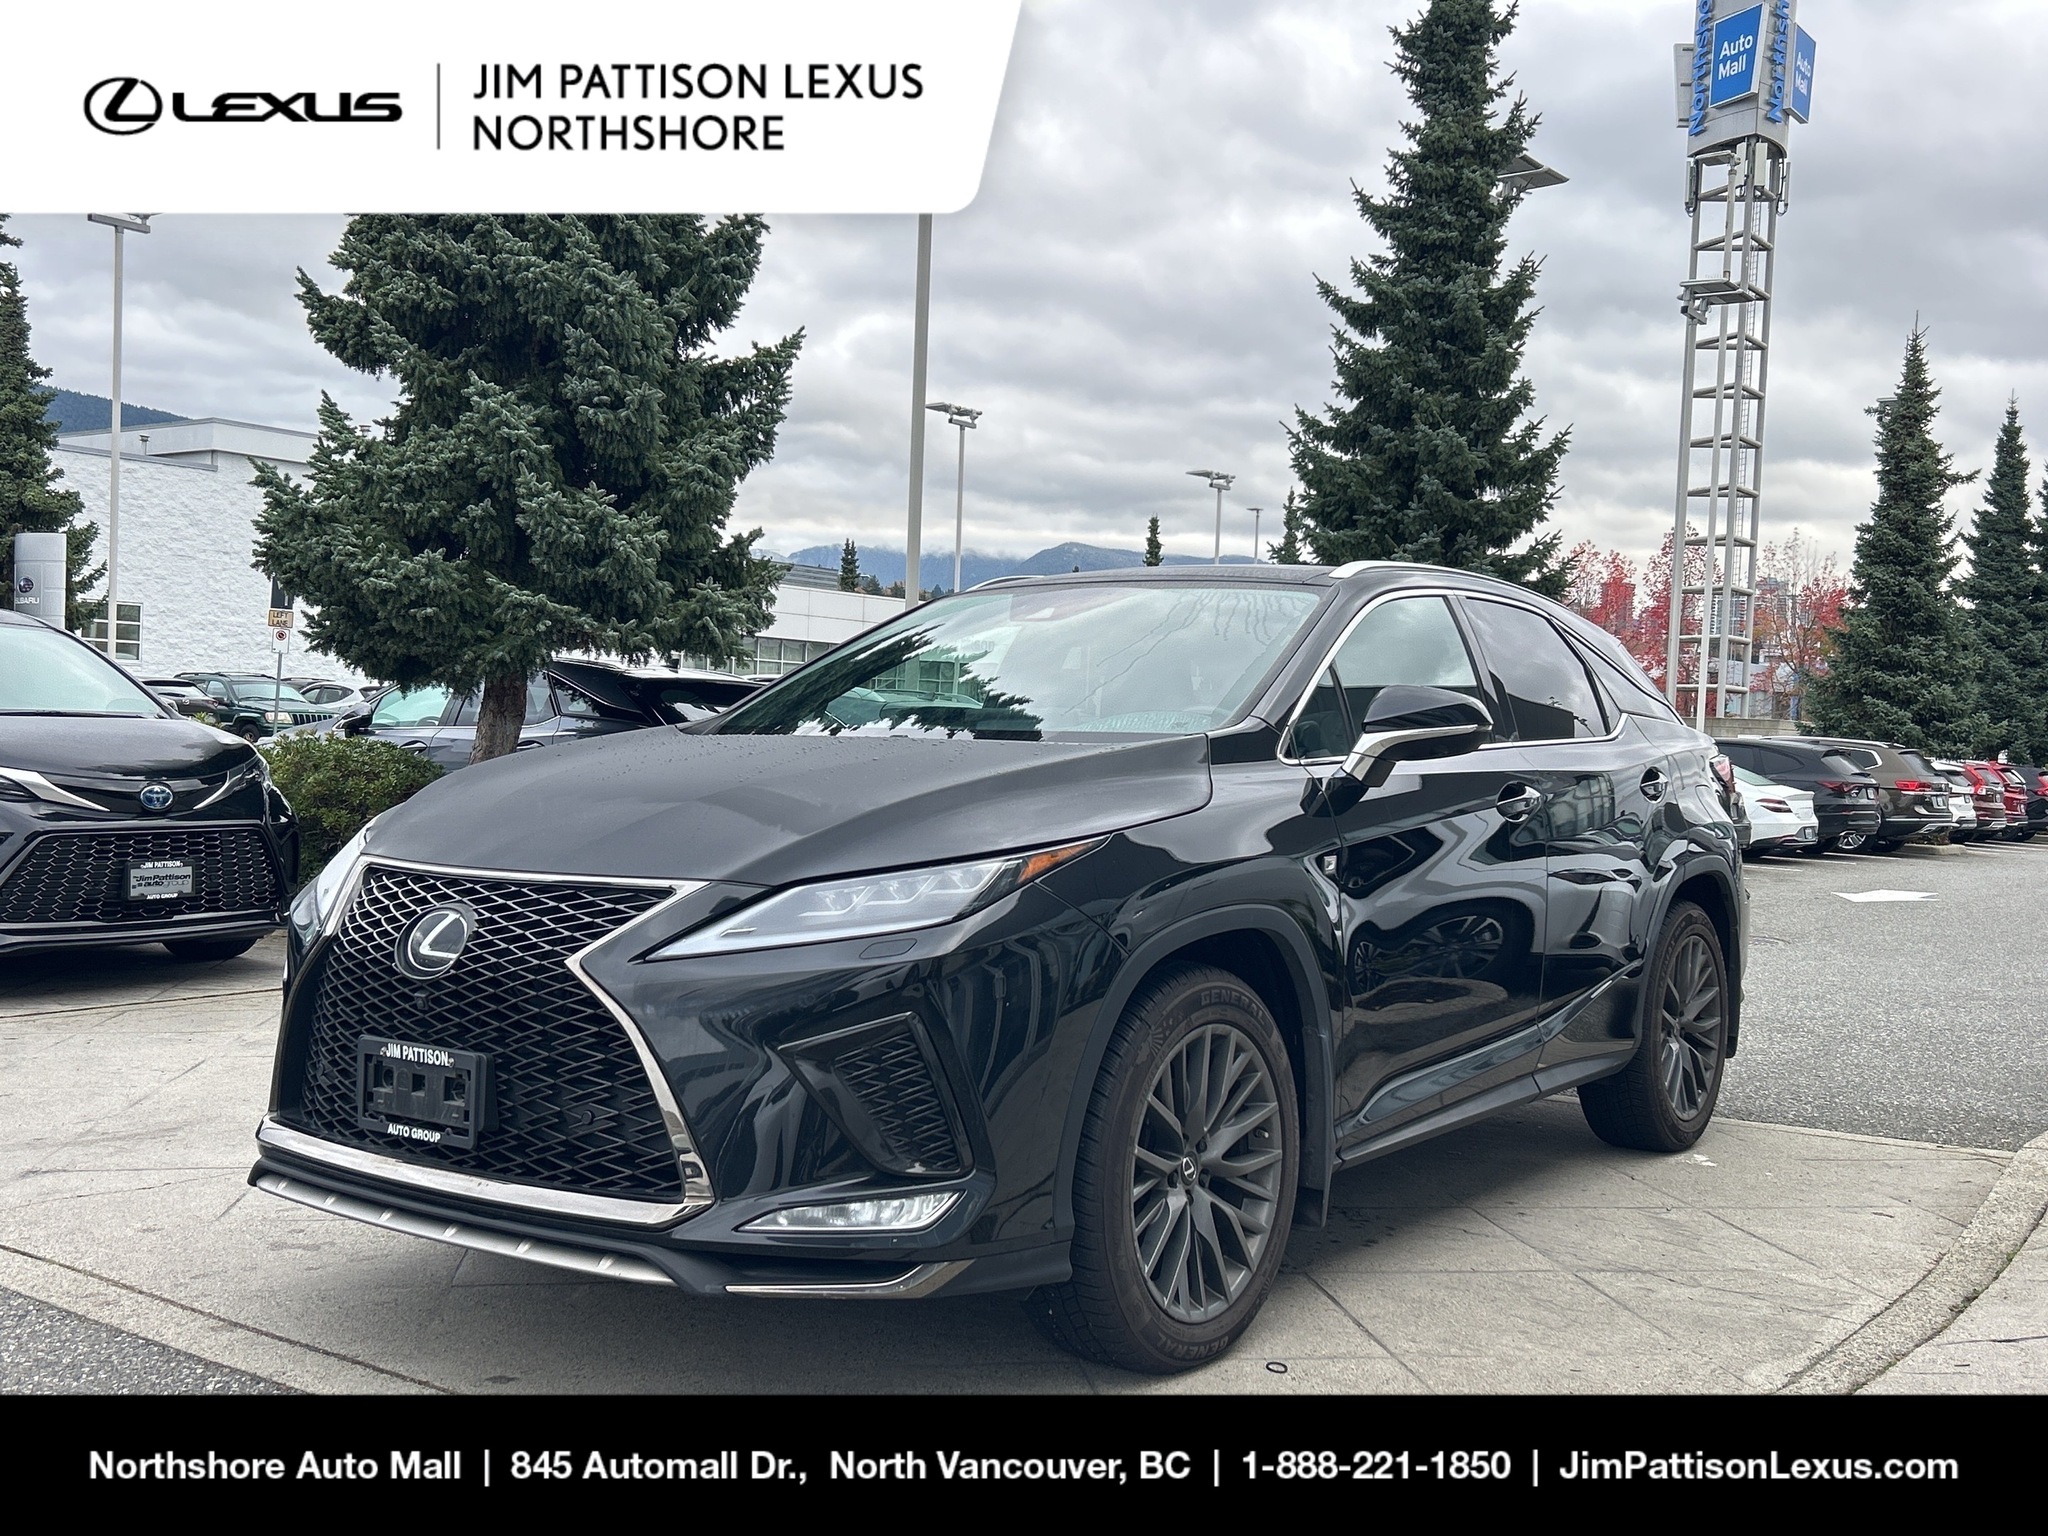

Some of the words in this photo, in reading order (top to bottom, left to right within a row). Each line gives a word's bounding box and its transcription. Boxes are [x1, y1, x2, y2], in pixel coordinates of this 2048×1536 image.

[1719, 34, 1754, 60] Auto
[1718, 55, 1747, 81] Mall
[1796, 51, 1812, 78] Auto
[1794, 70, 1809, 96] Mall
[272, 612, 289, 620] LEFT
[154, 860, 181, 868] PATTISON
[1200, 988, 1266, 1026] GENERAL
[385, 1042, 402, 1059] JIM
[402, 1045, 450, 1067] PATTISON
[387, 1122, 410, 1137] AUTO
[411, 1127, 441, 1143] GROUP
